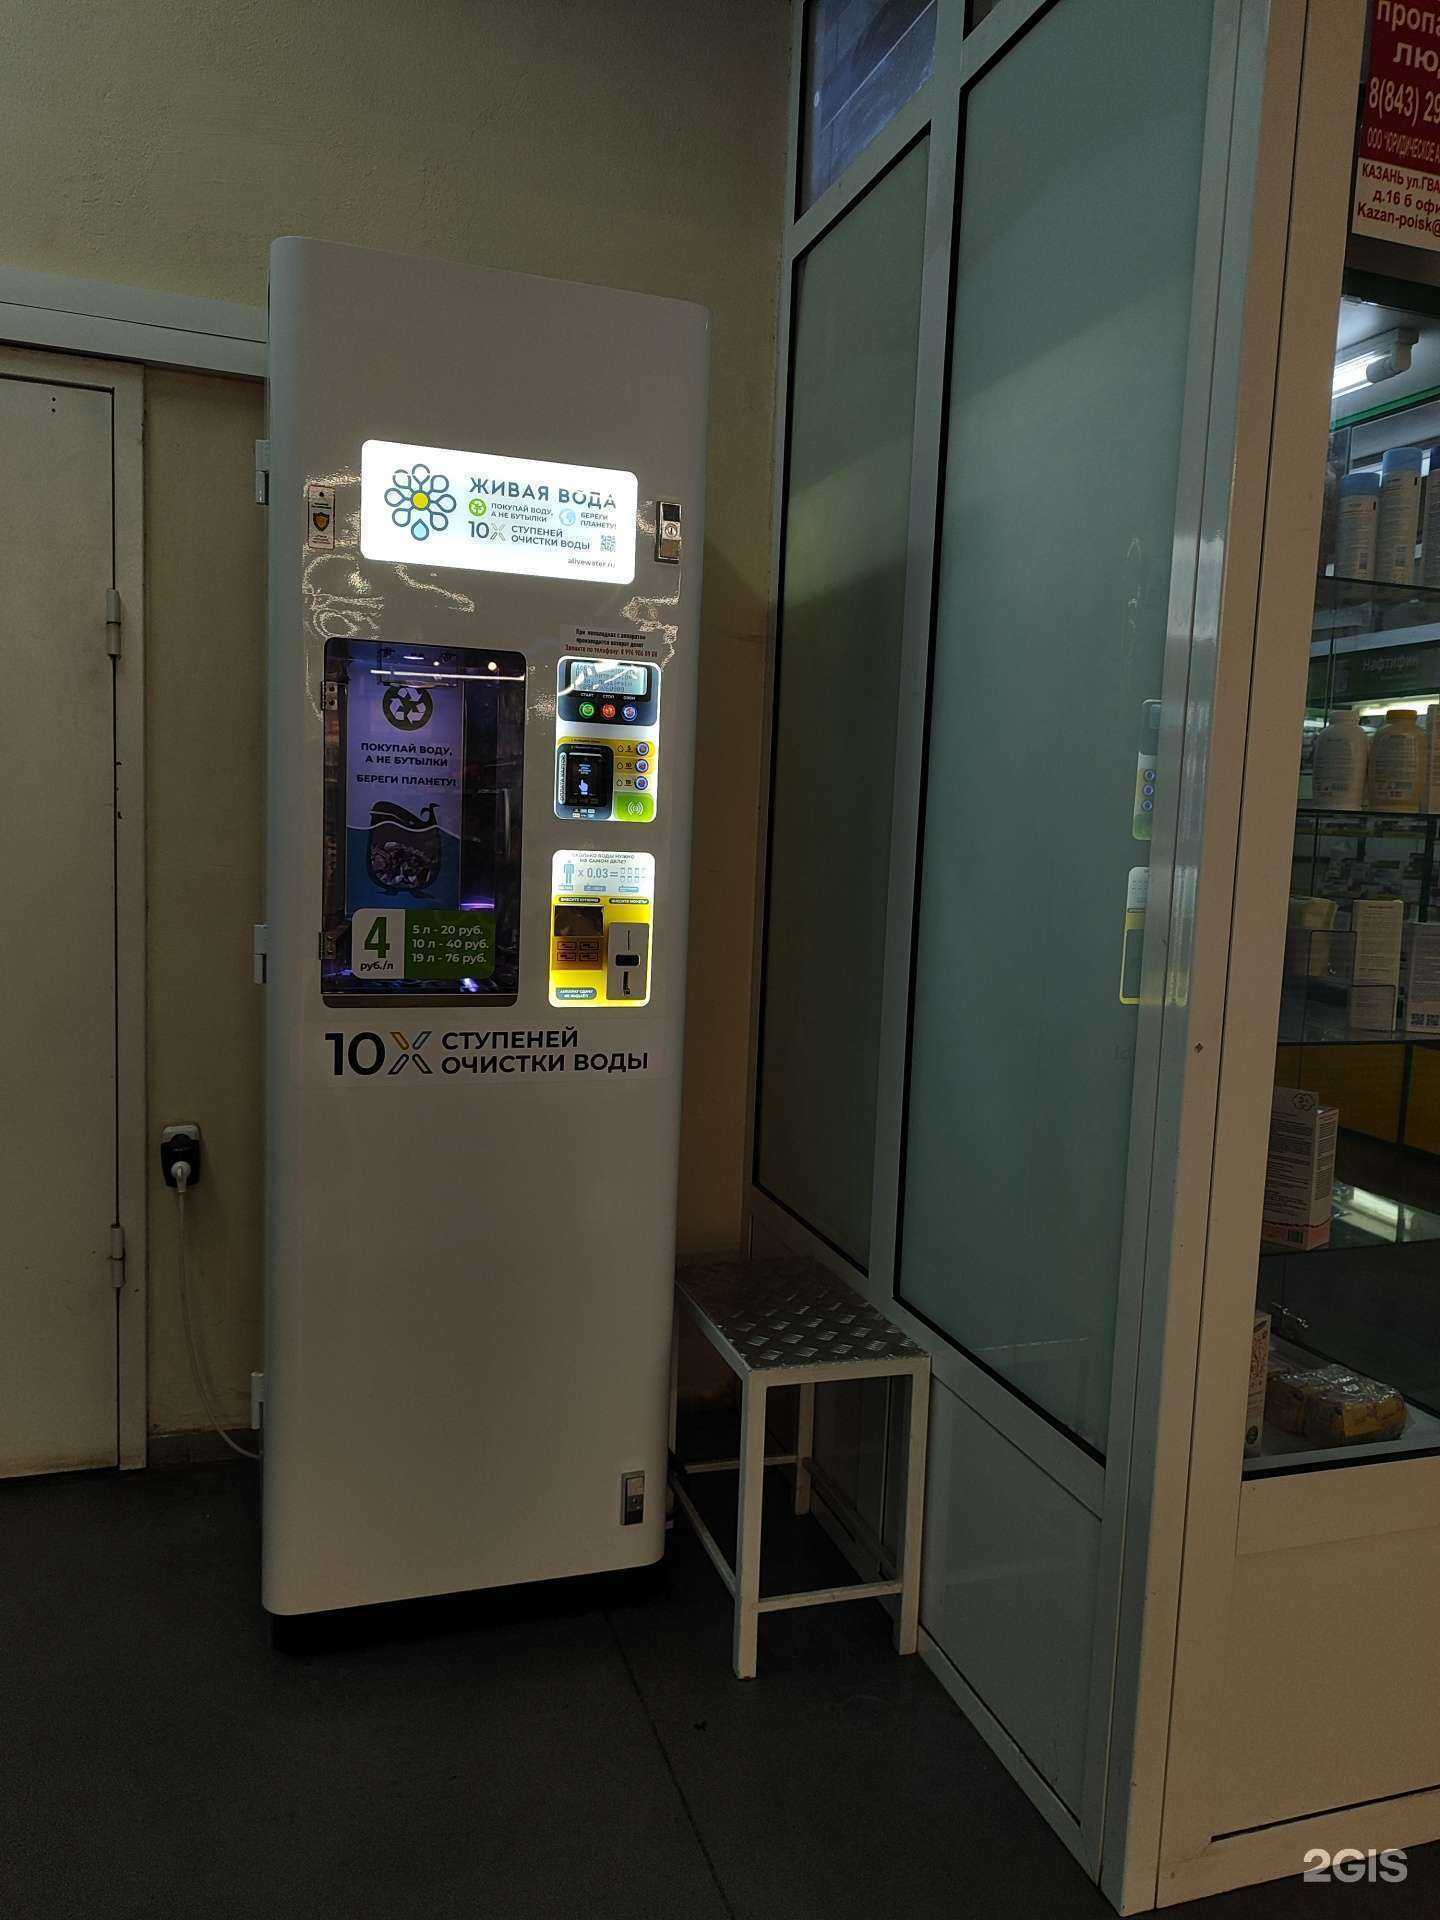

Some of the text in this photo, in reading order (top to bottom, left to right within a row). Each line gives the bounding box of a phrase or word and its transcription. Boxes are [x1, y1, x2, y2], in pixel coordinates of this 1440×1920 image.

[1393, 42, 1440, 79] лю
[1369, 77, 1420, 127] 8(843)
[1367, 127, 1383, 150] ООО
[1362, 162, 1404, 185] КАЗАНЬ
[1372, 190, 1400, 205] д.16
[469, 477, 616, 509] ЖИВАЯ ВОДА
[491, 502, 529, 513] ПОКУПАЙ
[511, 513, 547, 523] БУТЫЛКИ
[511, 525, 563, 538] СТУПЕНЕЙ
[511, 535, 590, 550] ОЧИСТКИ ВОДЫ
[361, 743, 453, 756] ПОКУПАЙ ВОДУ,
[365, 755, 448, 767] А НЕ БУТЫЛКИ
[357, 774, 456, 786] БЕРЕГИ ПЛАНЕТУ!
[587, 867, 608, 879] 0,03
[364, 916, 390, 959] 4
[412, 925, 420, 934] 5
[441, 925, 456, 935] 20
[459, 925, 484, 937] руб.
[412, 939, 424, 949] 10
[428, 941, 435, 949] л
[447, 939, 462, 949] 40
[464, 939, 489, 951] руб.
[412, 953, 424, 963] 19
[427, 955, 435, 963] л
[445, 953, 460, 963] 76
[462, 953, 487, 965] руб.
[360, 961, 394, 971] руб./л
[442, 1026, 579, 1050] СТУПЕНЕЙ
[441, 1052, 648, 1075] ОЧИСТКИ ВОДЫ
